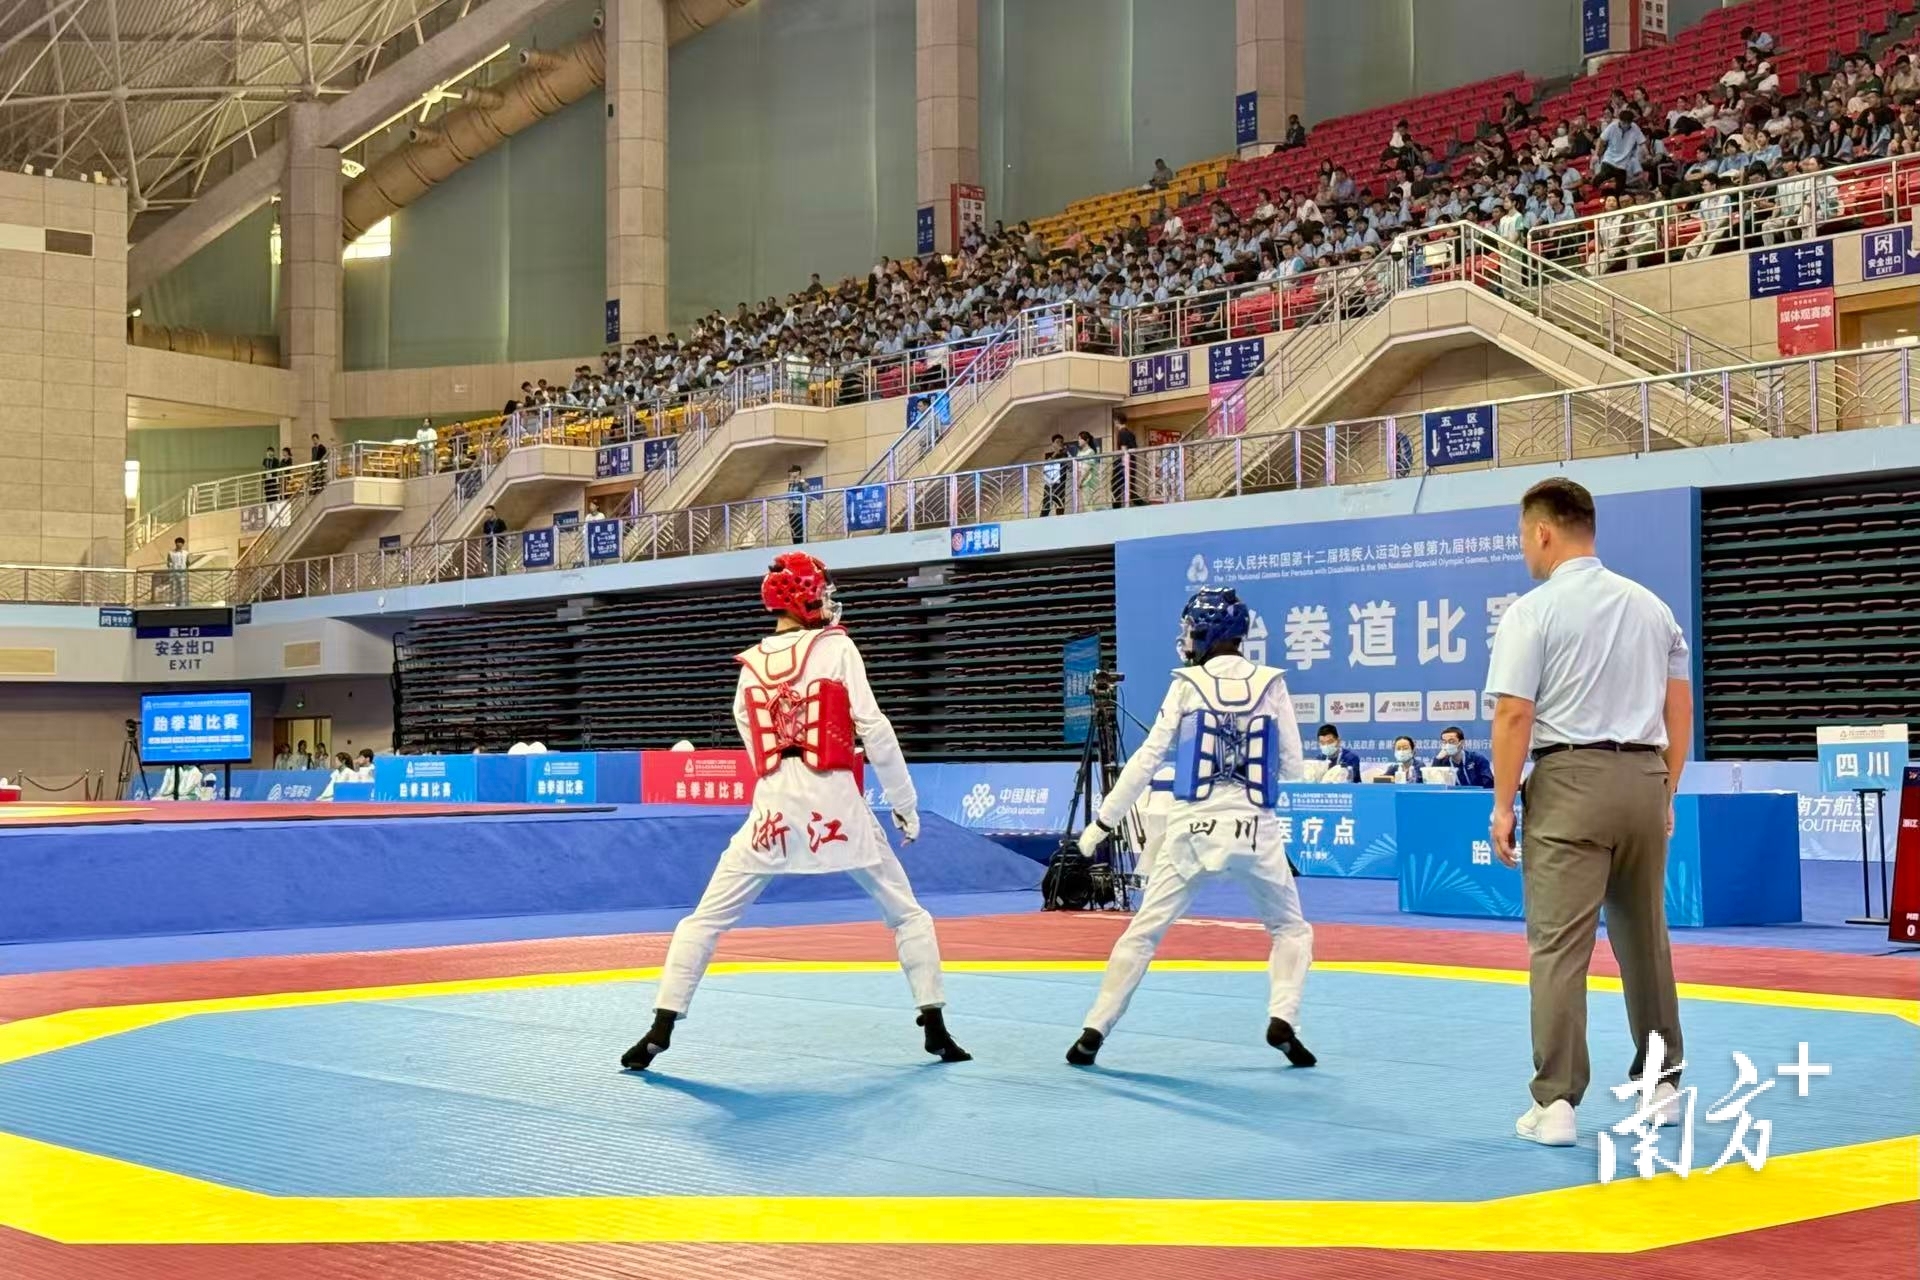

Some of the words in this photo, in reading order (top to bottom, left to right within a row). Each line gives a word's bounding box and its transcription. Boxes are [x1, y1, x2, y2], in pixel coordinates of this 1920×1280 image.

[1759, 252, 1779, 265] 十区
[1794, 245, 1824, 260] 十一区
[1868, 255, 1901, 269] 安全出口
[1876, 265, 1893, 275] EXIT
[1213, 534, 1524, 574] 中华人民共和国第十二届残疾人运动会暨第九届特殊奥林
[155, 640, 215, 657] 安全出口
[169, 658, 202, 670] EXIT
[153, 713, 239, 732] 跆拳道比赛
[1836, 751, 1890, 778] 四川
[400, 781, 451, 797] 跆拳道比赛
[538, 779, 583, 795] 跆拳道比赛
[676, 781, 744, 799] 跆拳道比赛
[1000, 787, 1049, 804] 中国联通
[996, 805, 1017, 815] China
[1018, 805, 1046, 815] unicom
[752, 808, 849, 858] 浙江
[1189, 815, 1259, 853] 四川
[1274, 816, 1355, 845] 医疗点
[1907, 924, 1916, 936] 0
